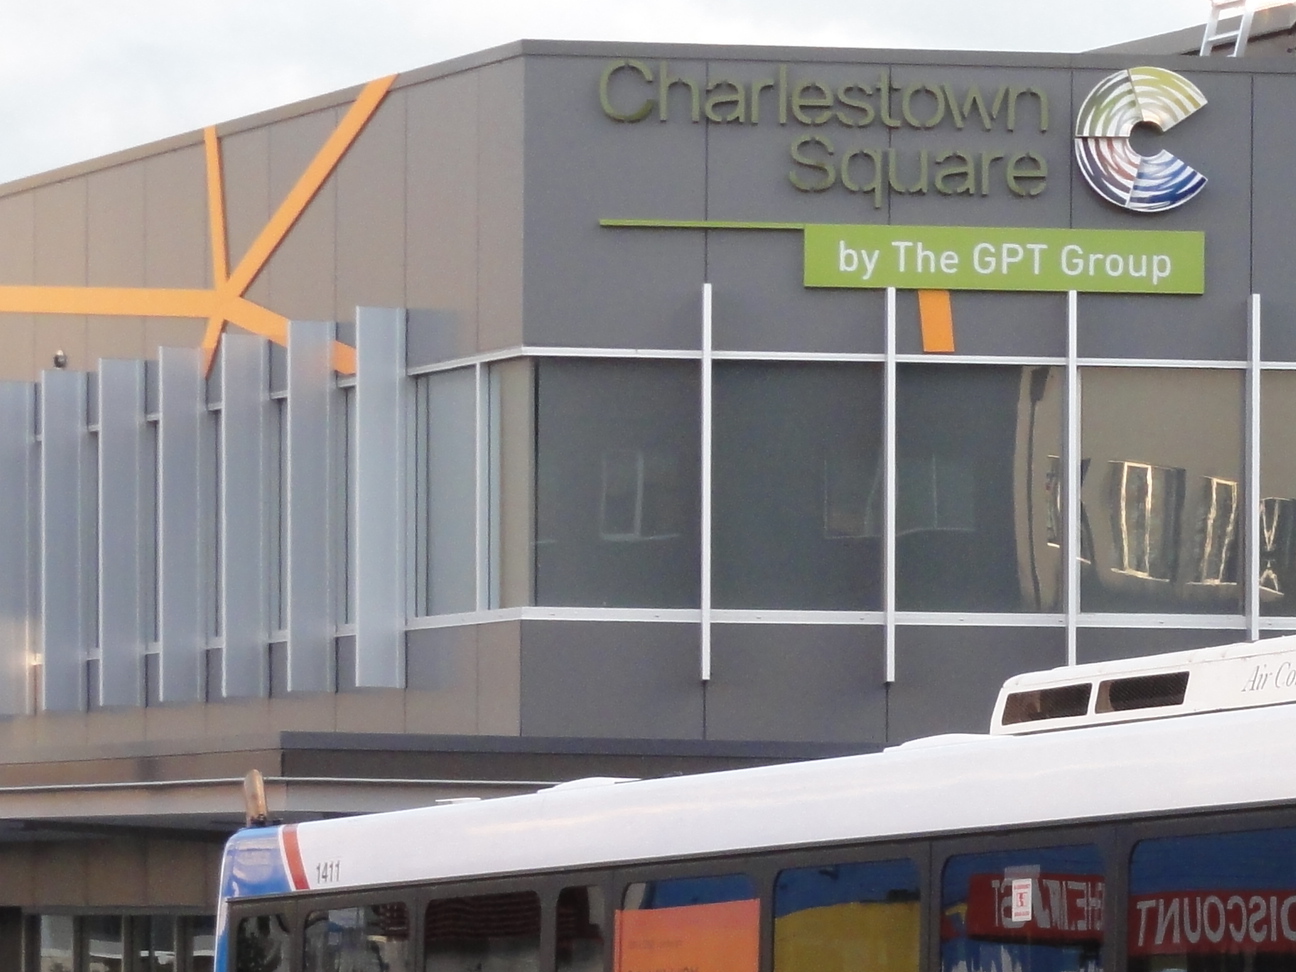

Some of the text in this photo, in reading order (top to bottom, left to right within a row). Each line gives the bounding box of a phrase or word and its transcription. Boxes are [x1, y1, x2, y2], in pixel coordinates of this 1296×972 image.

[599, 59, 1049, 131] Charlestown
[788, 135, 1048, 209] Square
[838, 240, 1172, 285] by The GPT Group
[1241, 665, 1274, 692] Air
[315, 860, 341, 884] 1411
